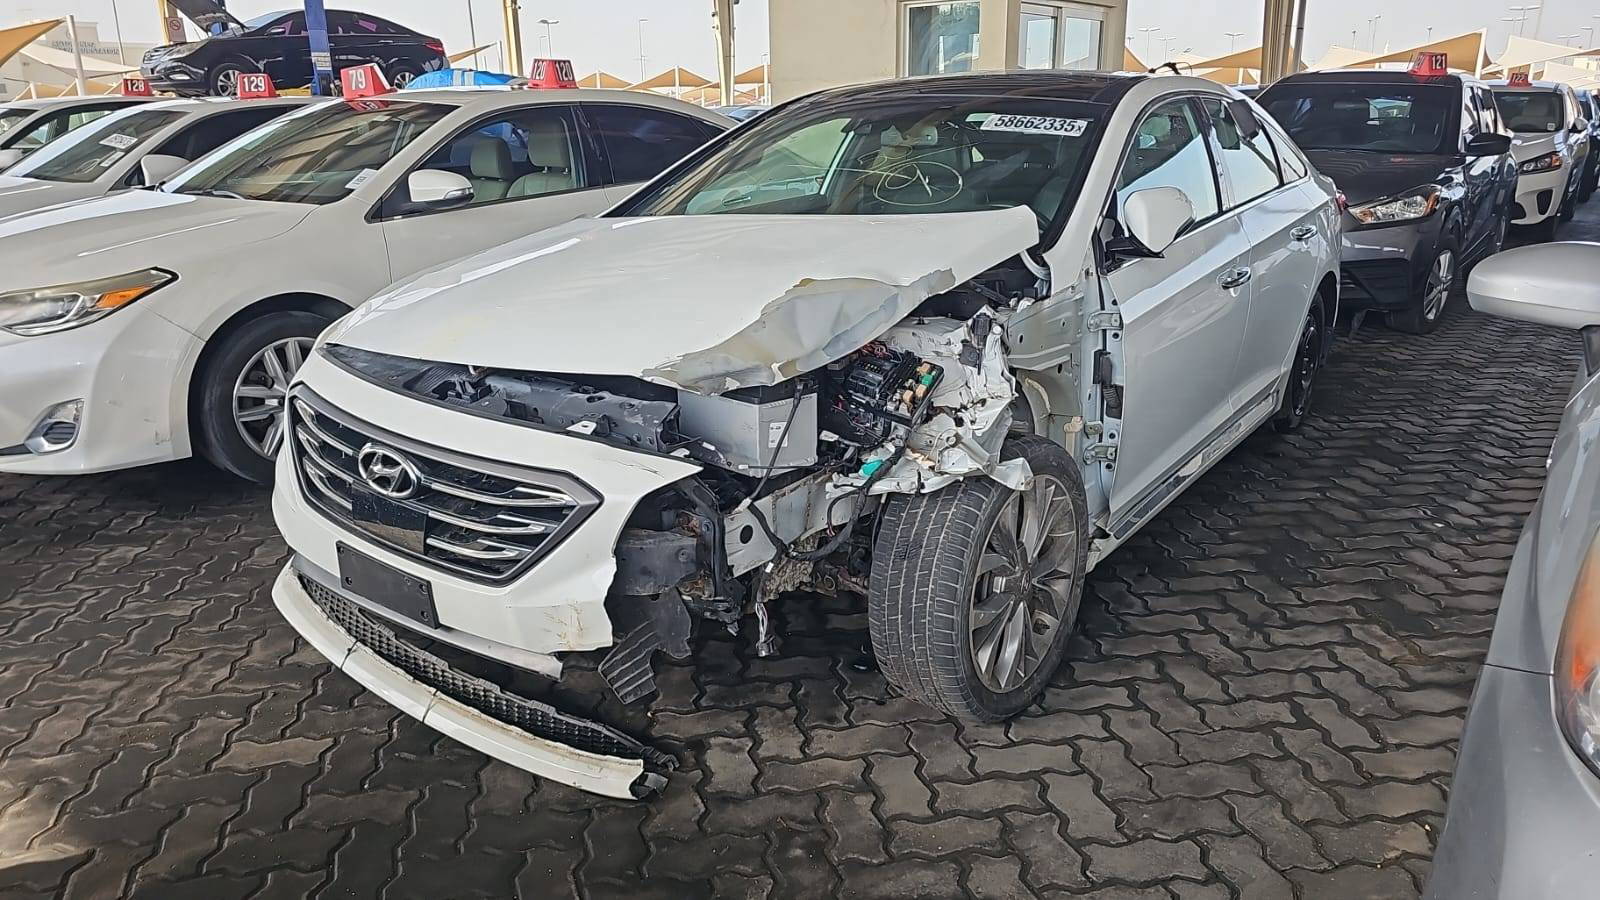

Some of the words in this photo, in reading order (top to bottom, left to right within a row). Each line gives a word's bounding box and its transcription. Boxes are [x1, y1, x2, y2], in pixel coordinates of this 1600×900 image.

[532, 60, 548, 80] 120
[556, 61, 573, 81] 120
[1432, 55, 1446, 70] 121
[126, 79, 145, 92] 128
[243, 76, 265, 92] 129
[348, 69, 366, 91] 79
[994, 115, 1077, 133] 58662335
